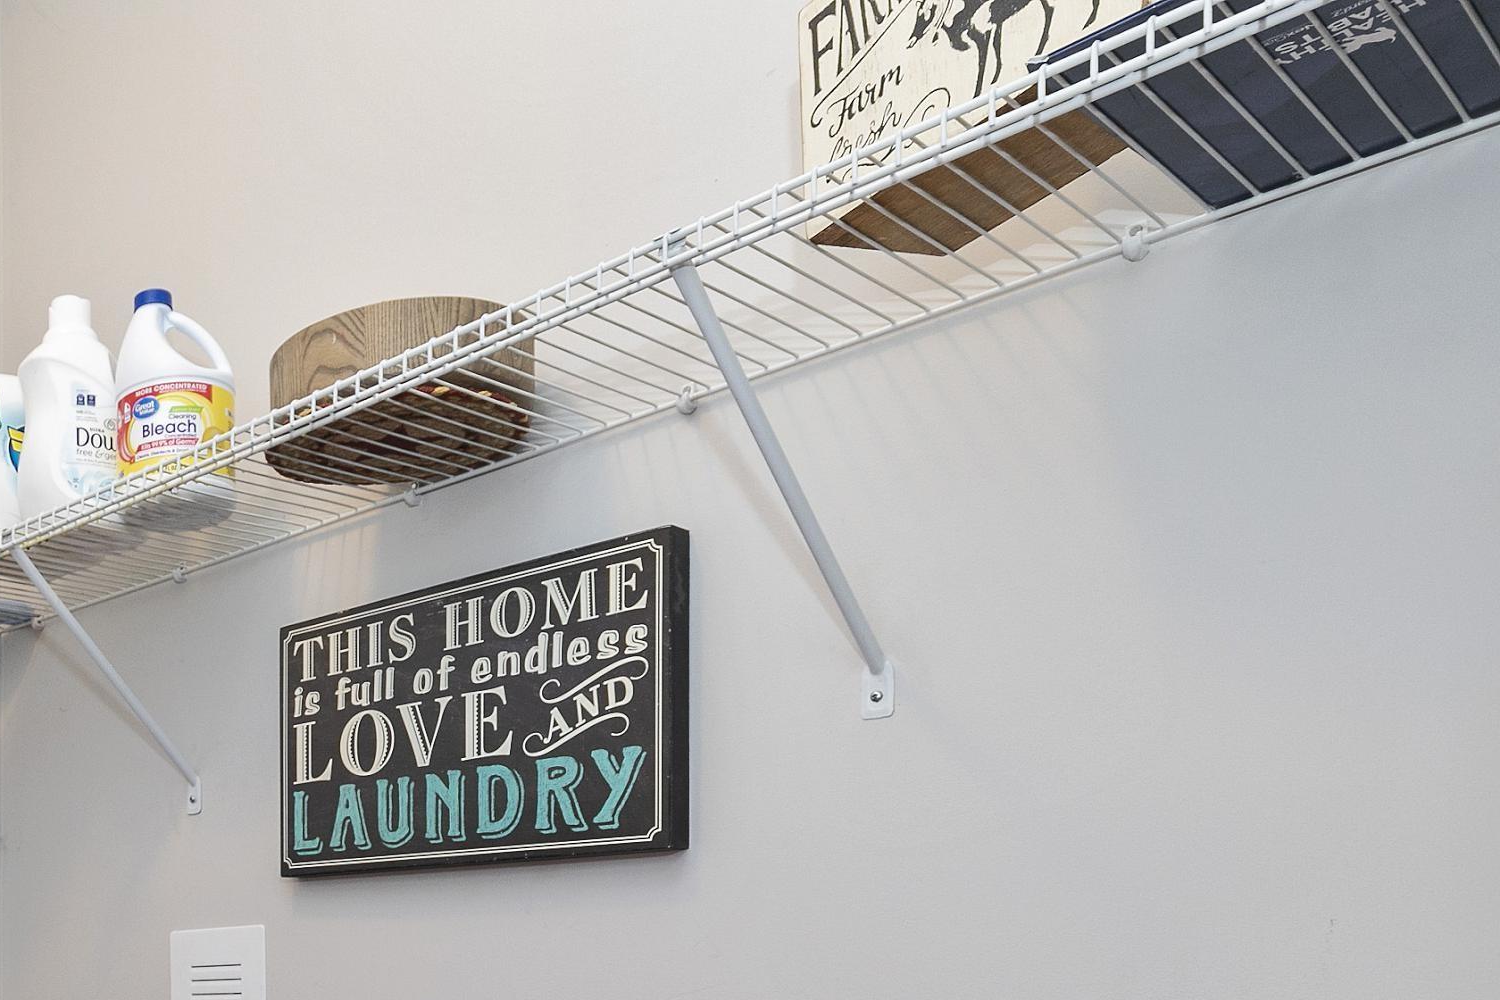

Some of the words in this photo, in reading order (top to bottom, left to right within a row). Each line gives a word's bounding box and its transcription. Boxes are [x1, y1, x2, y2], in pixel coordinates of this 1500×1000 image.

[827, 65, 904, 137] Farm
[134, 400, 155, 411] Great
[135, 386, 152, 397] MORE
[153, 383, 208, 392] CONCENTRATED
[76, 448, 93, 457] free
[142, 420, 197, 438] Bleach
[293, 612, 417, 683] THIS
[443, 557, 649, 652] HOME
[293, 686, 321, 718] is
[335, 666, 397, 711] full
[412, 654, 455, 695] of
[470, 623, 649, 685] endless
[292, 684, 514, 786] LOVE
[542, 675, 635, 744] AND
[292, 745, 647, 856] LAUNDRY
